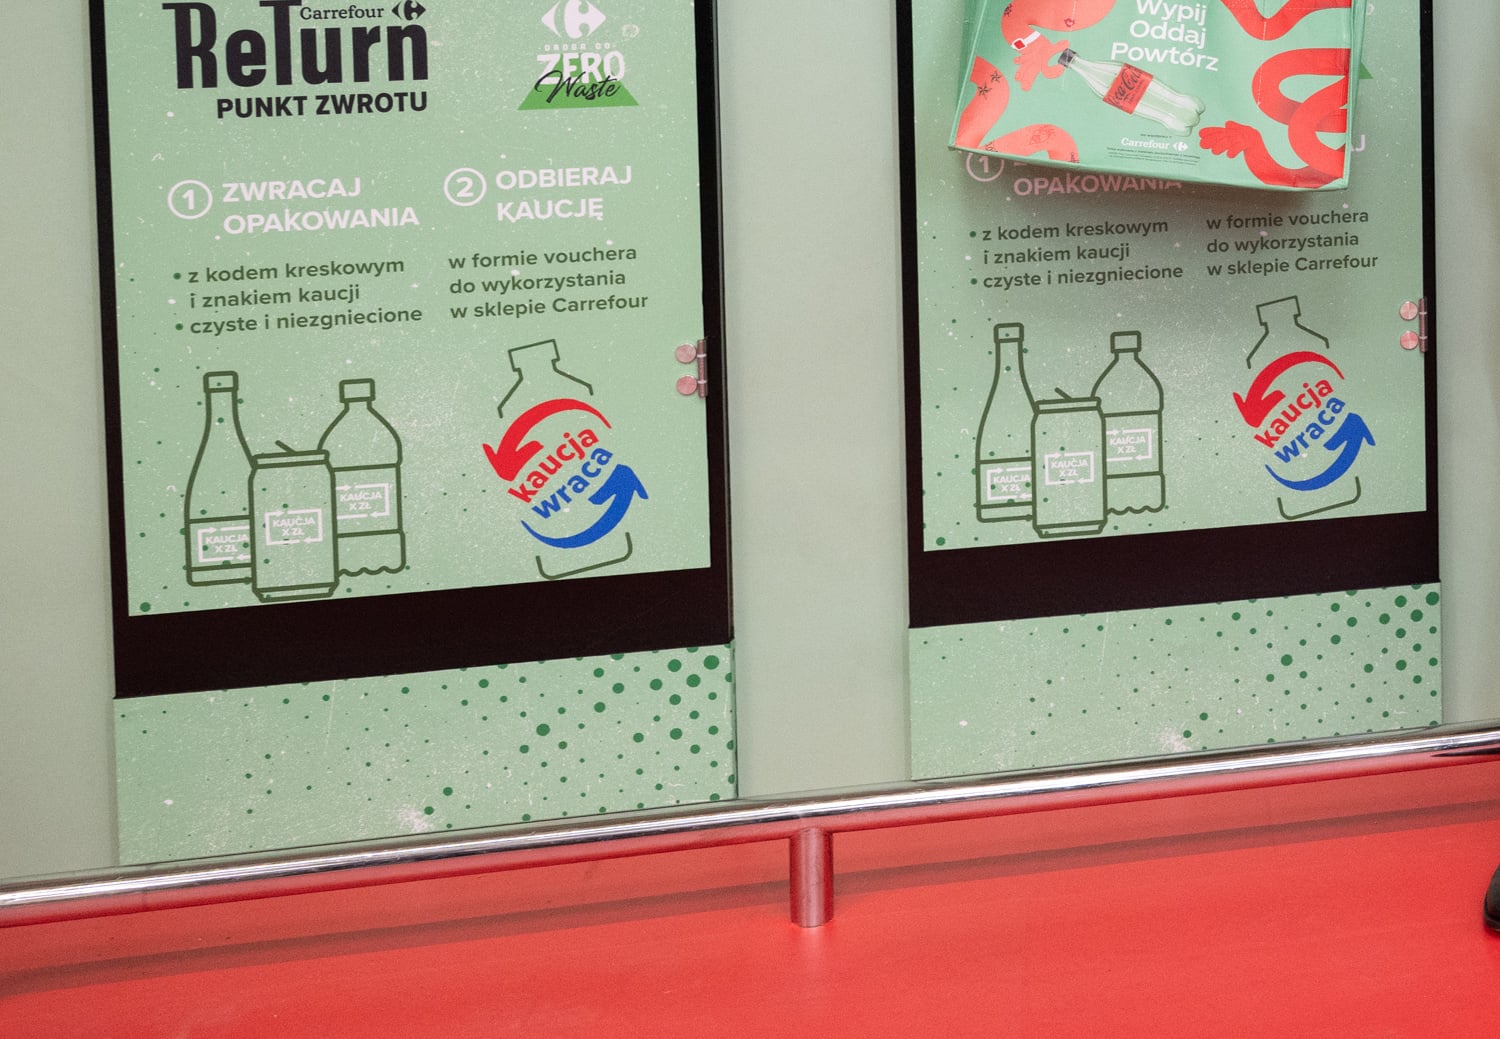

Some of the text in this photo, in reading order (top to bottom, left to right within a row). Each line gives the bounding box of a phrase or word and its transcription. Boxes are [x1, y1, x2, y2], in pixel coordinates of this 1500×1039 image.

[299, 4, 385, 21] Carrefour
[1130, 20, 1206, 49] Oddaj
[537, 51, 625, 84] ZERO
[1111, 42, 1219, 71] Powtórz
[534, 70, 622, 103] Waste
[217, 91, 428, 118] PUNKT ZWROTU
[1120, 137, 1170, 149] Carrefour
[182, 176, 361, 210] 1 ZWRACAJ
[456, 165, 632, 198] 2 ODBIERAJ
[223, 207, 420, 234] OPAKOWANIA
[497, 197, 604, 223] KAUCJĘ
[1206, 209, 1369, 230] w formie vouchera
[982, 219, 1169, 241] z kodem kreskowym
[983, 243, 1130, 265] i znakiem kaucji
[1206, 233, 1359, 254] do wykorzystania
[449, 247, 637, 269] w formie vouchera
[1207, 254, 1378, 278] w sklepie Carrefour
[188, 260, 404, 283] z kodem kreskowym
[450, 270, 626, 295] do wykorzystania
[983, 264, 1184, 291] czyste i niezgniecione
[190, 284, 360, 308] i znakiem kaucji
[450, 295, 648, 318] w sklepie Carrefour
[190, 307, 422, 336] czyste i niezgniecione
[1253, 379, 1334, 449] kaucja
[1274, 397, 1346, 463] wraca
[507, 428, 599, 503] kaucja
[531, 448, 614, 519] wraca
[340, 491, 382, 502] KAUCJA
[350, 502, 372, 511] X ZŁ
[273, 517, 315, 528] KAUCJA
[282, 527, 304, 536] X ZŁ
[206, 533, 249, 544] KAUCJA
[215, 544, 237, 553] X ZŁ
